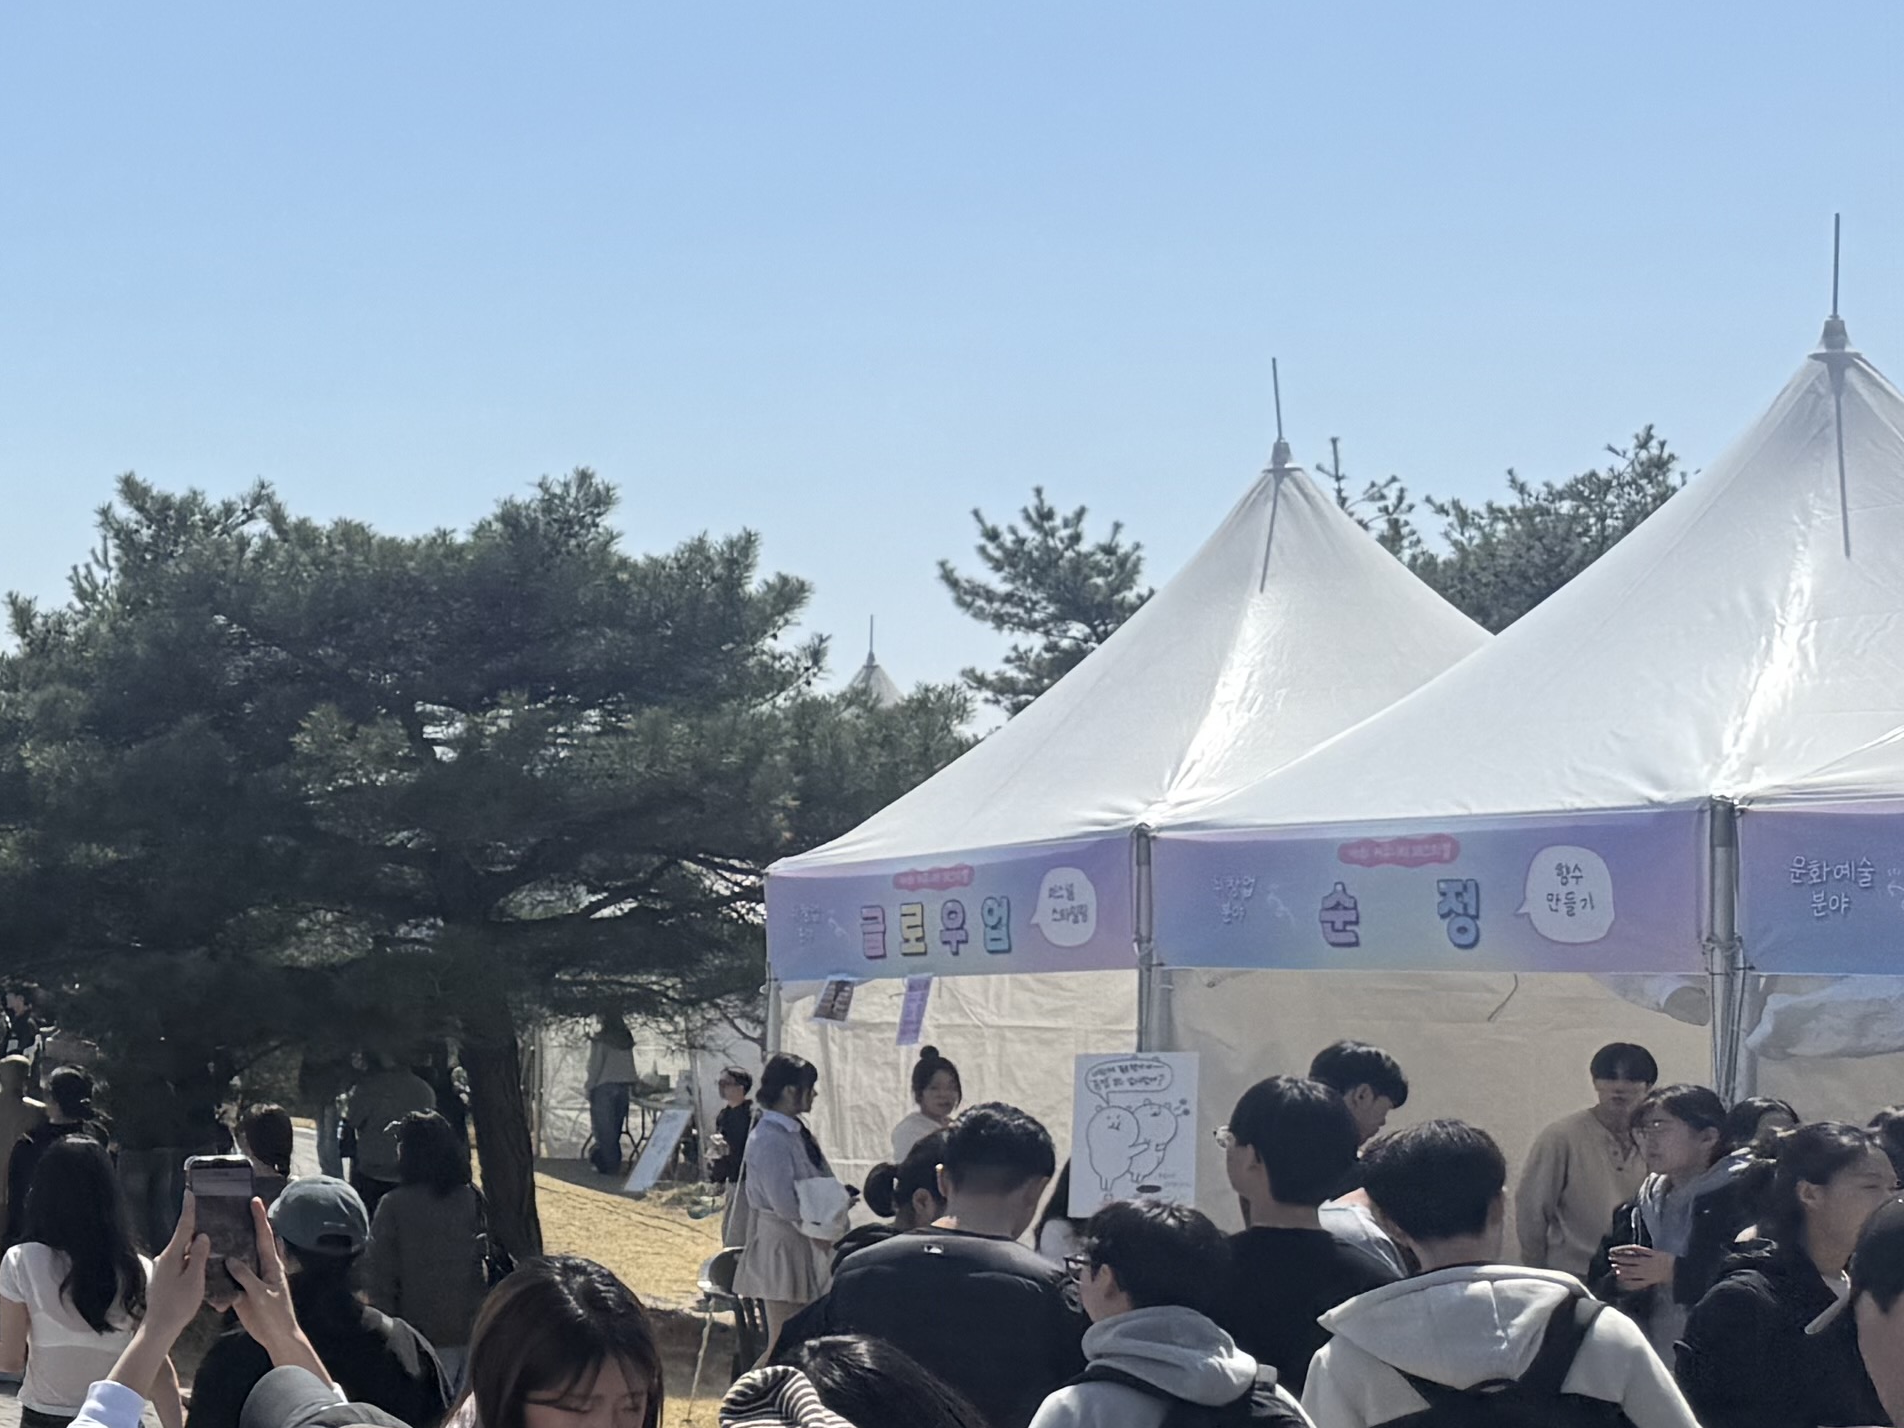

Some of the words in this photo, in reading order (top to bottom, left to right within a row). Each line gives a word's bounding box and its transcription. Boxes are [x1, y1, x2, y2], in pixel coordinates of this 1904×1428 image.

[1555, 862, 1583, 886] 향수
[1790, 856, 1875, 888] 문화예술
[1546, 891, 1595, 917] 만들기
[1811, 890, 1849, 917] 분야
